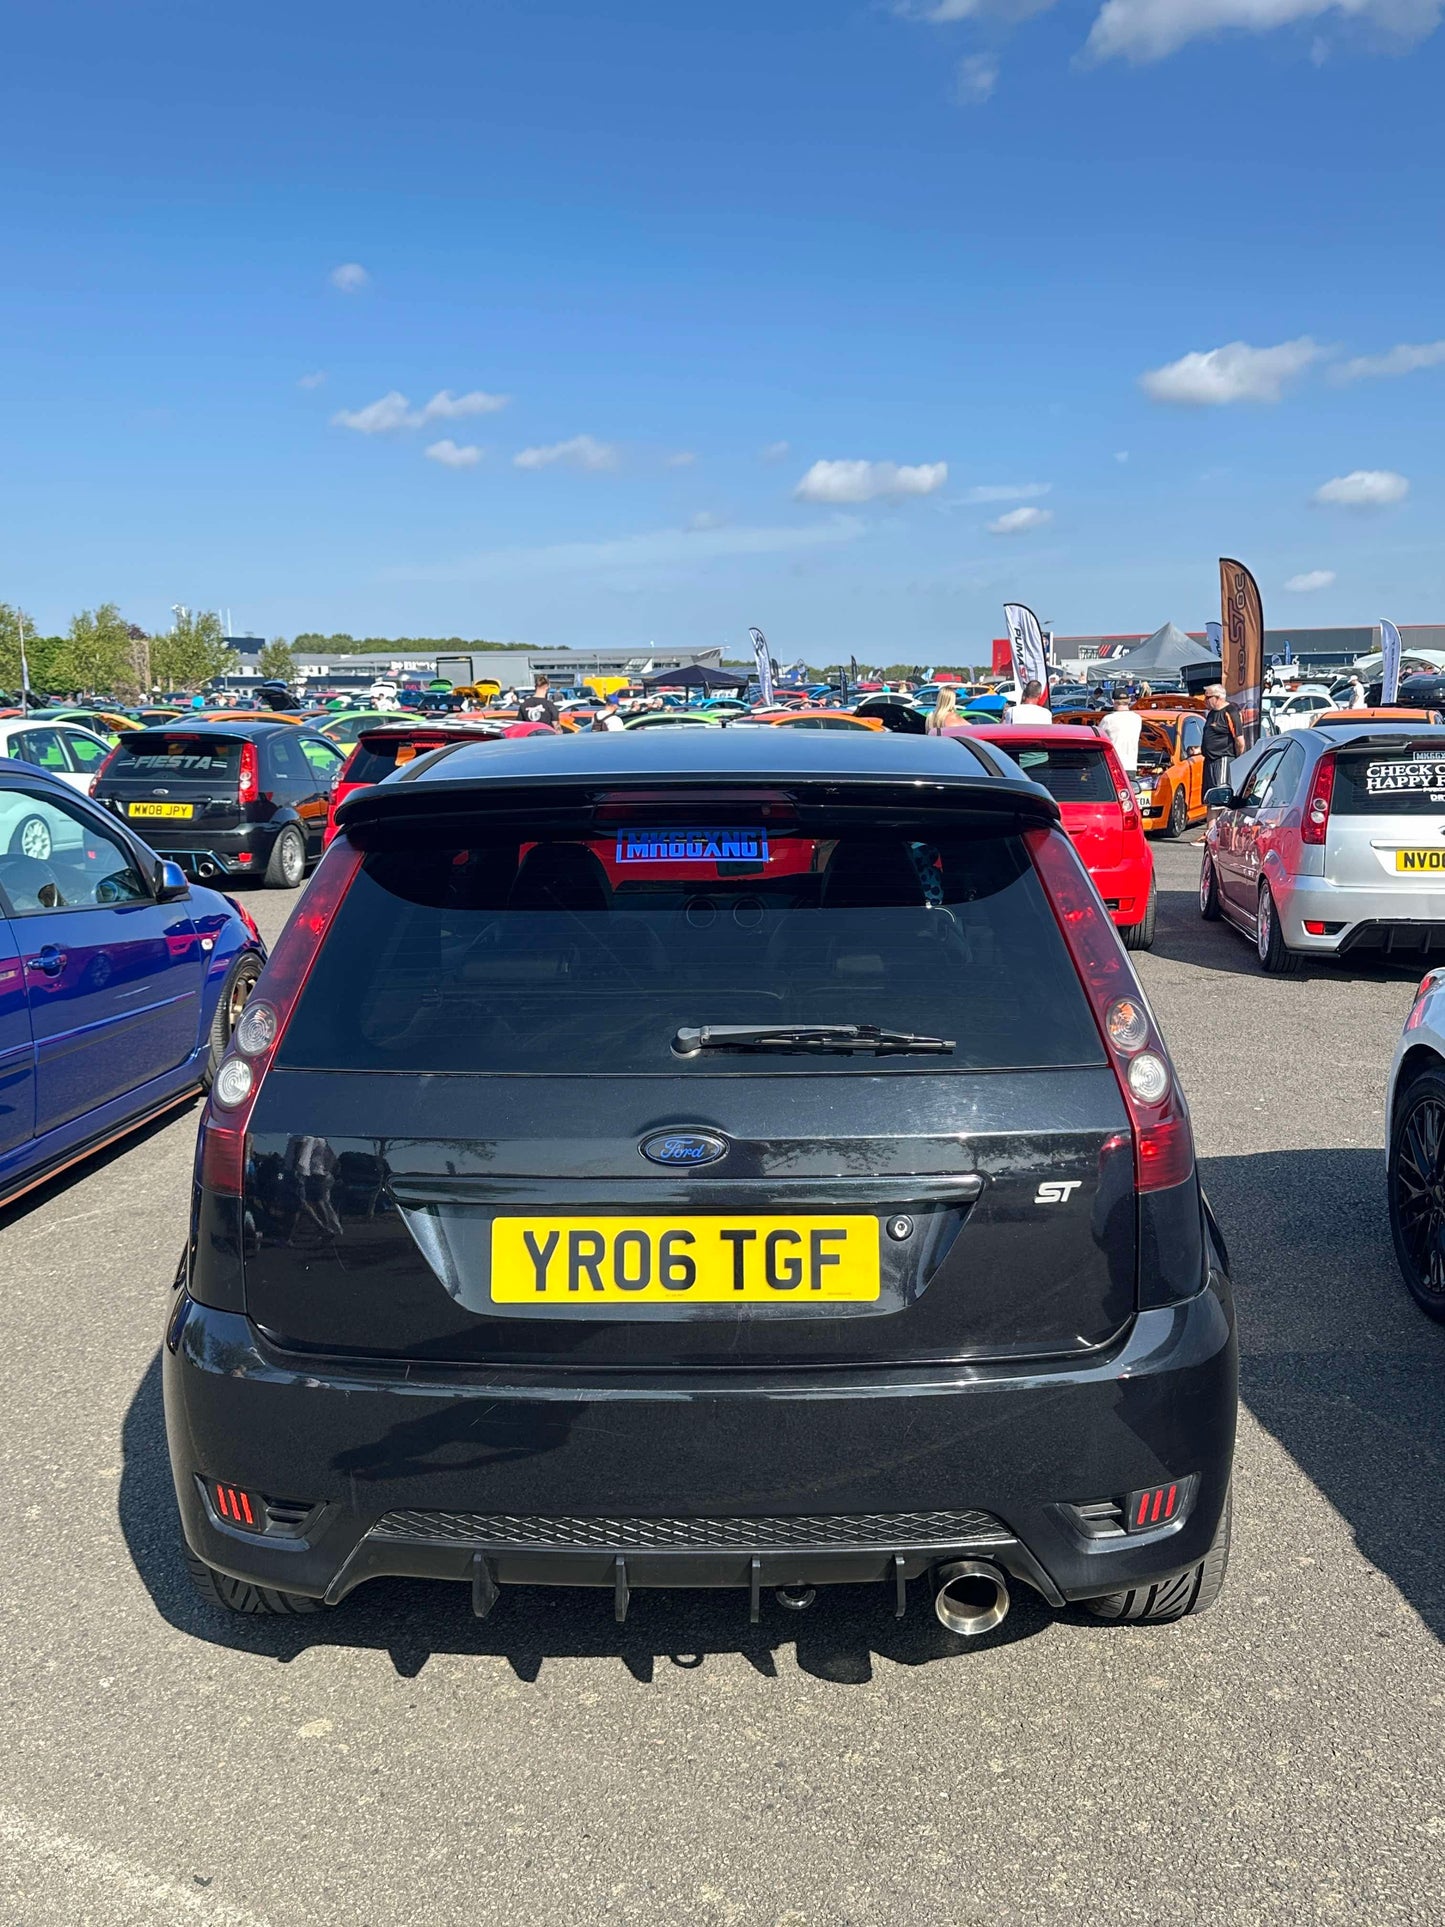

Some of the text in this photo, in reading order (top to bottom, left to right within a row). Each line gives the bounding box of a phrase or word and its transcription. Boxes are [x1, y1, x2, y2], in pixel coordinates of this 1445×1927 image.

[1013, 627, 1026, 666] PUMA
[133, 755, 213, 770] FIESTA
[1366, 764, 1433, 778] CHECK
[1366, 775, 1434, 790] HAPPY
[134, 805, 189, 817] MW08 JPY
[659, 1139, 706, 1159] Ford
[1034, 1180, 1083, 1204] ST
[523, 1229, 847, 1292] YR06 TGF
